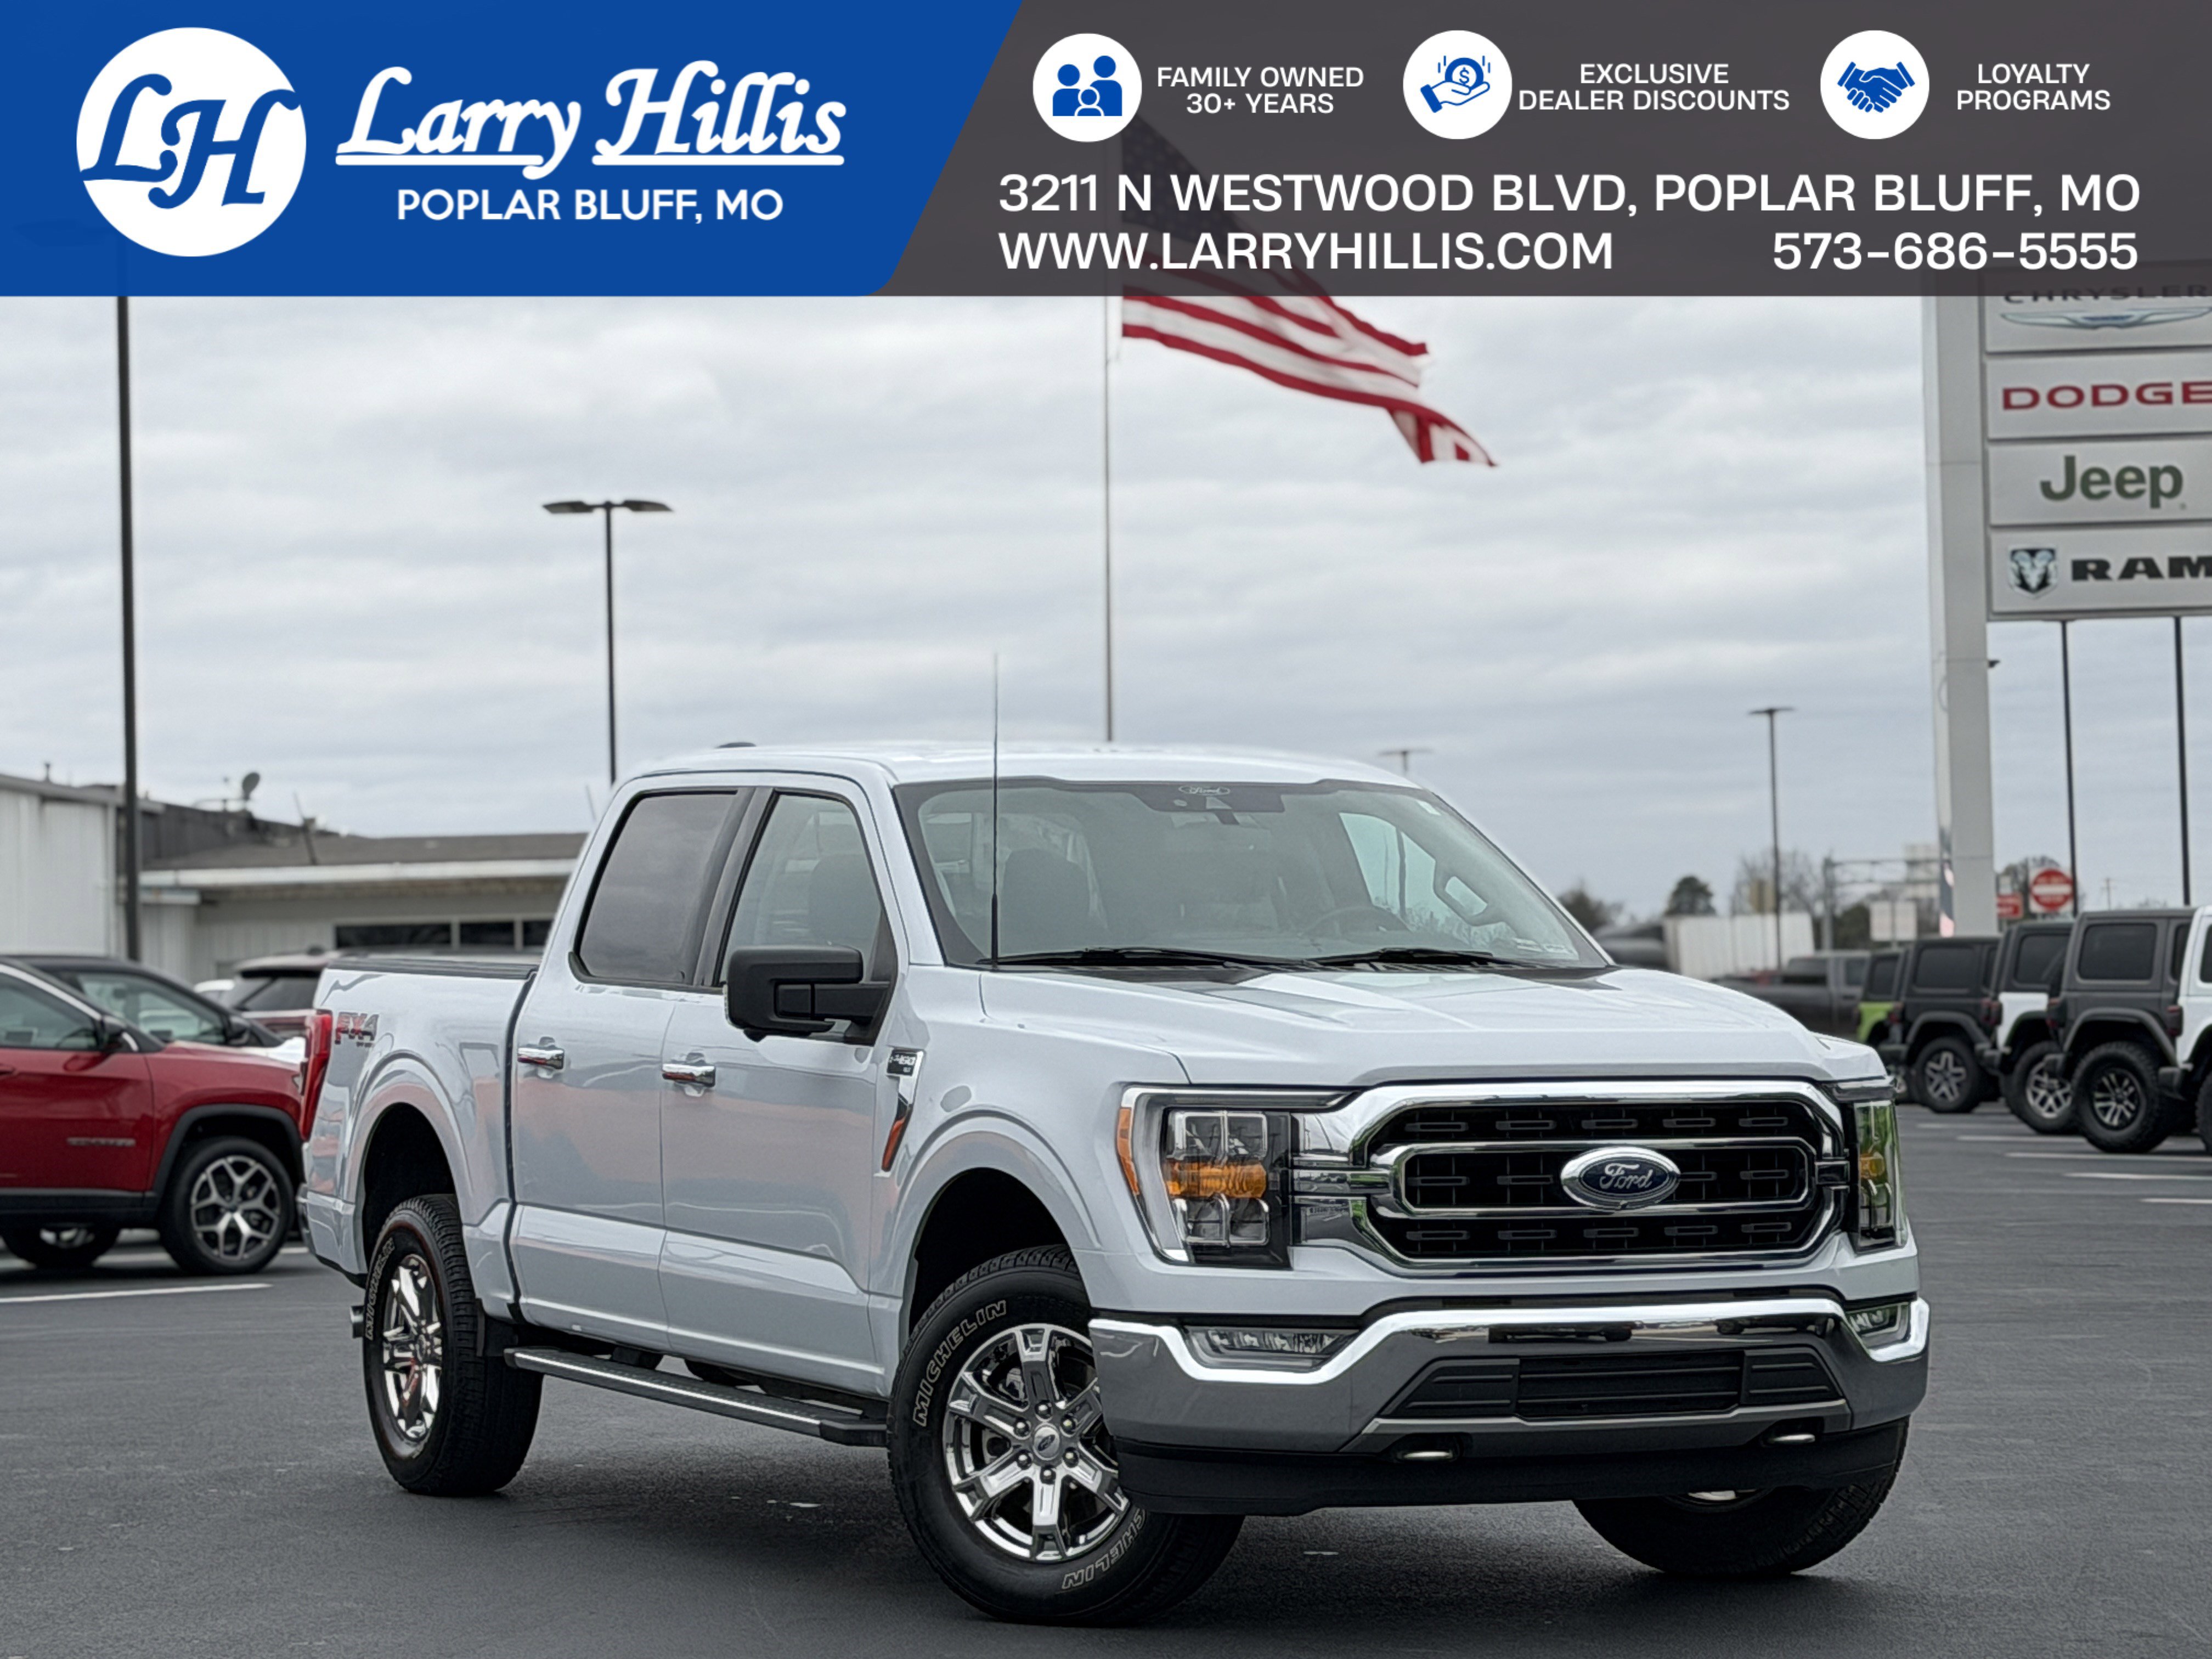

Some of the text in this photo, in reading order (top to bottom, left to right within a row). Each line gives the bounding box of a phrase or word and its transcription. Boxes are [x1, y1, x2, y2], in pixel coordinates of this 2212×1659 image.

[2002, 381, 2212, 410] DODGE
[2039, 454, 2183, 509] Jeep
[2071, 555, 2212, 582] RAM
[1599, 1162, 1654, 1189] Ford
[912, 1299, 1007, 1427] MICHELIN
[1062, 1508, 1146, 1590] CHELIN
